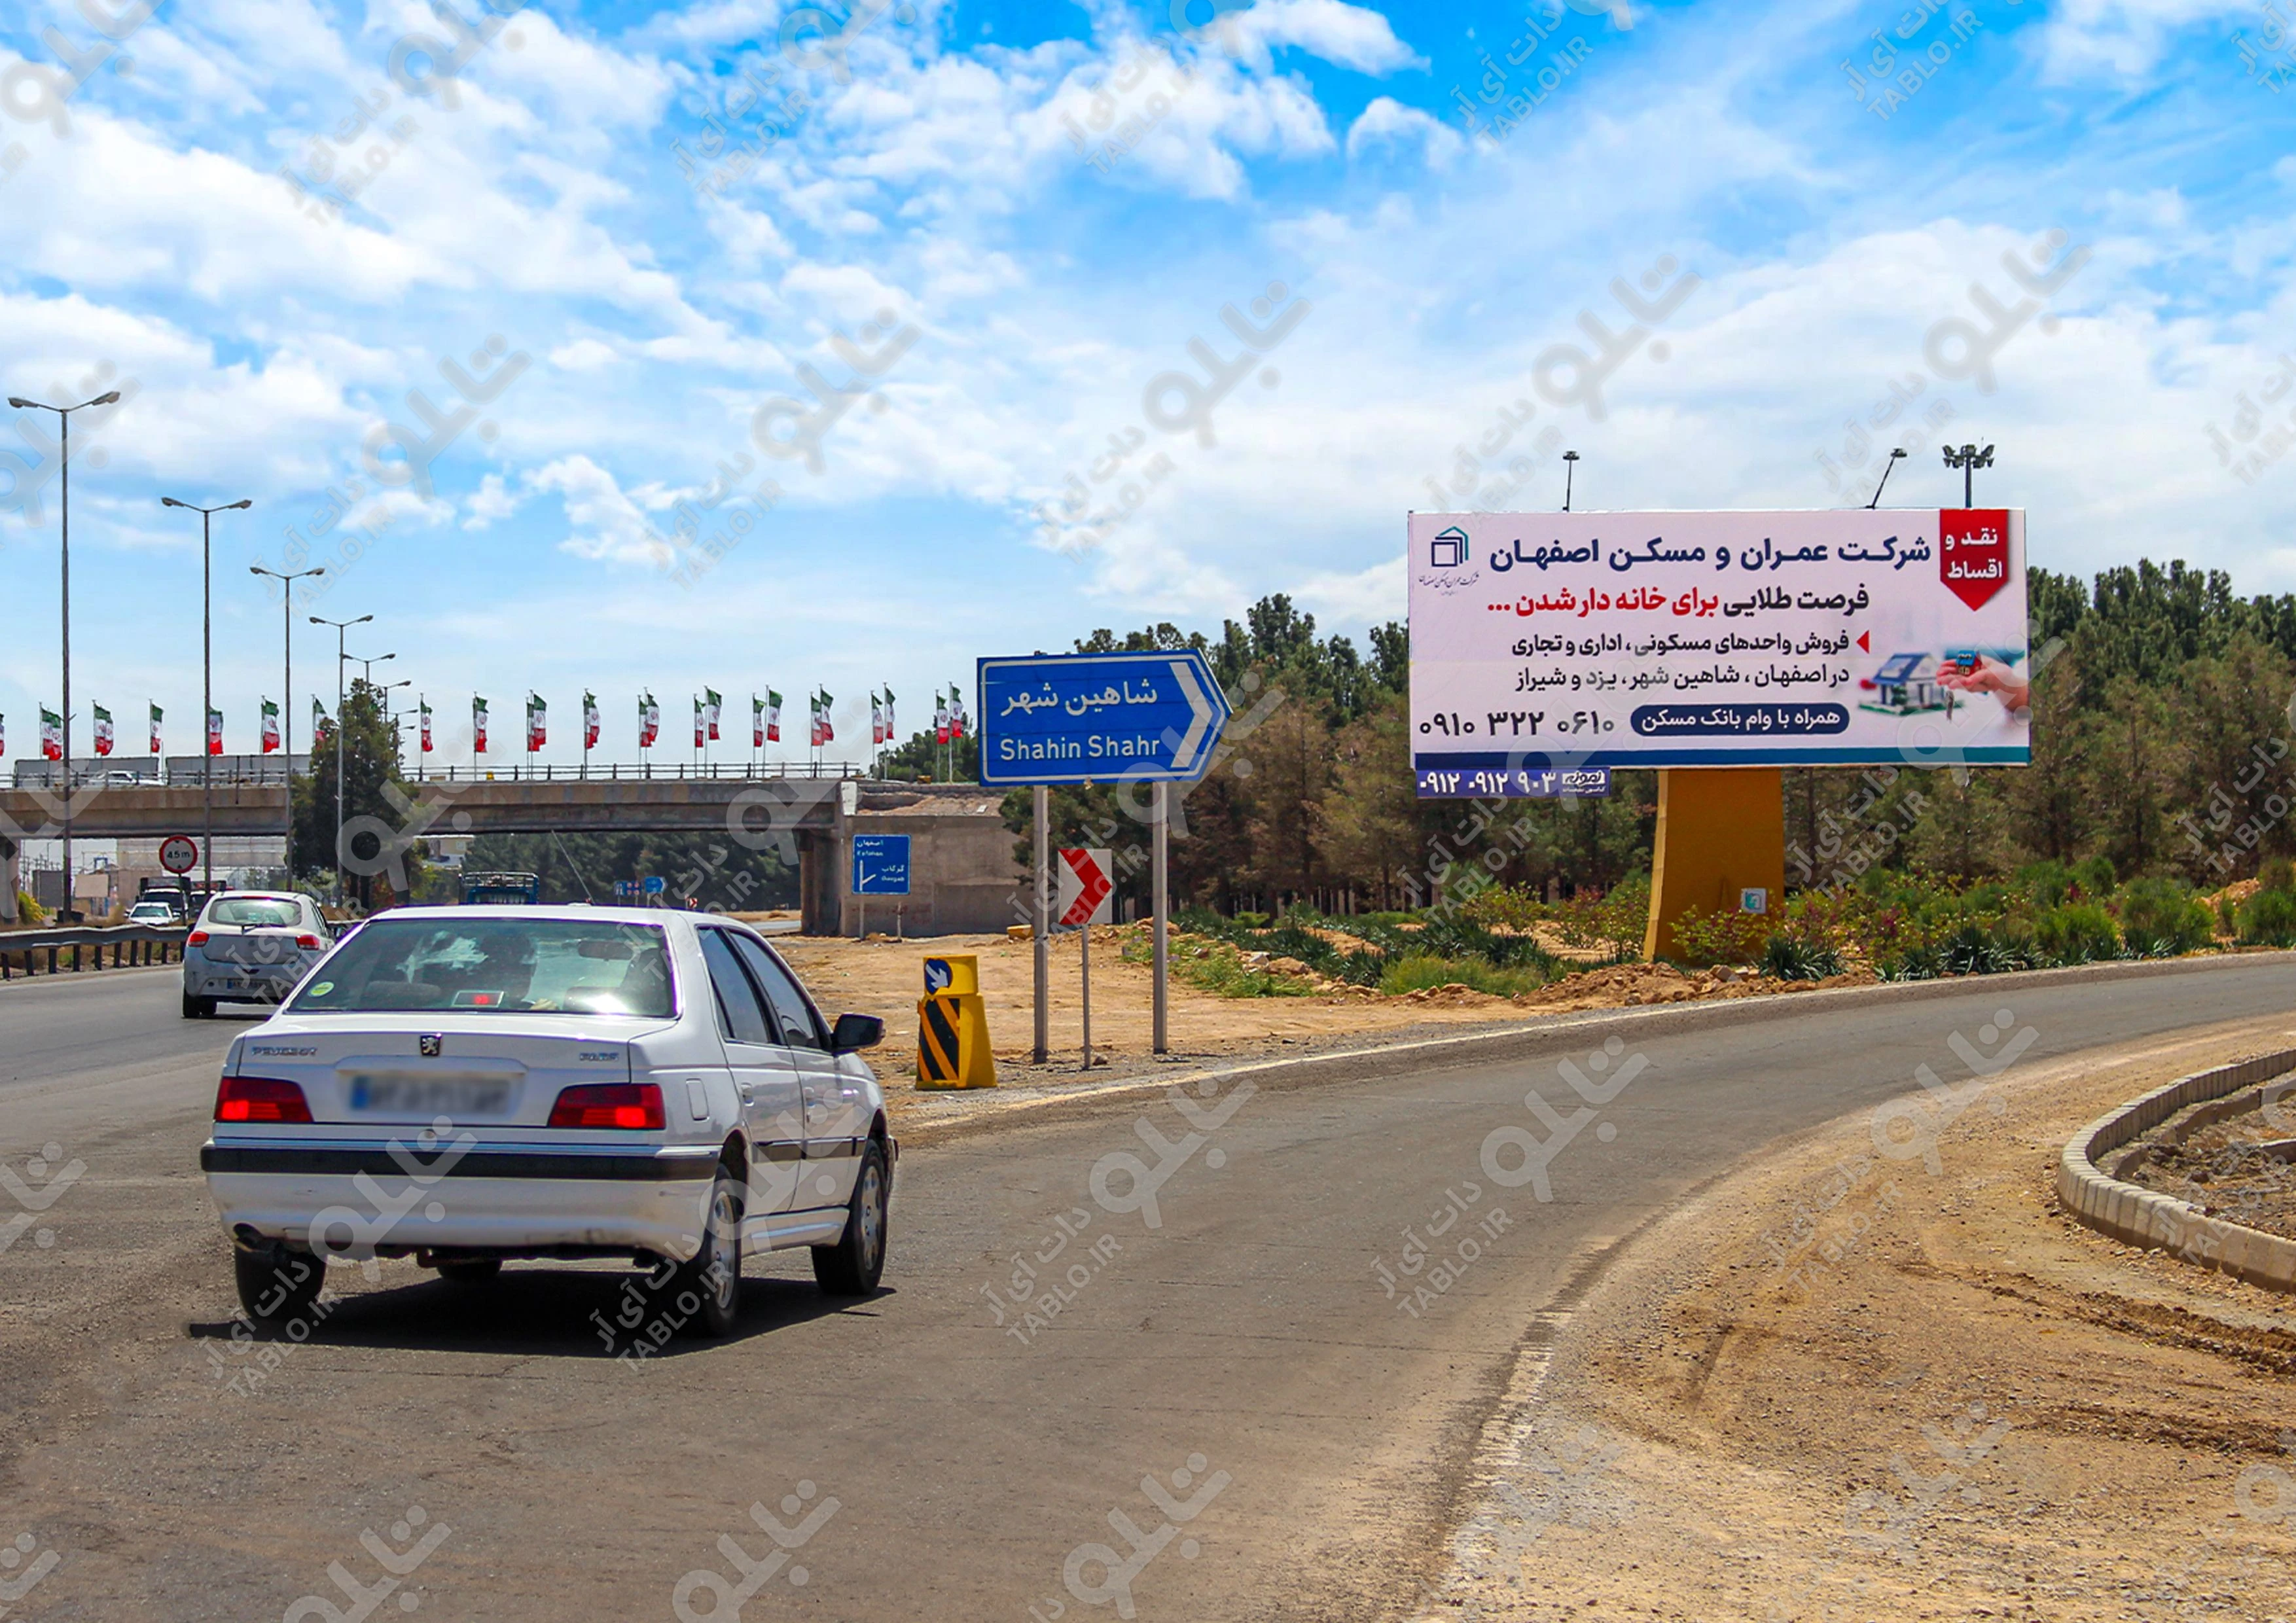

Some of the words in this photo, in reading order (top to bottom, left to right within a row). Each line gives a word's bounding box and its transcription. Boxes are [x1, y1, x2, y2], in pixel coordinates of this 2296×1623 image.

[1945, 533, 1956, 552] و
[1961, 527, 1998, 546] نقد
[1490, 539, 1599, 572] اصفهان
[1609, 537, 1706, 572] مسکن
[1715, 546, 1731, 571] و
[1741, 538, 1828, 571] عمران
[1838, 537, 1931, 570] شرکت
[1947, 561, 2002, 579] اقساط
[1616, 586, 1666, 610] خانه
[1672, 587, 1719, 617] برای
[1723, 586, 1792, 616] طلایی
[1797, 583, 1869, 616] فرصت
[1512, 634, 1563, 656] تجاری
[1566, 641, 1575, 656] و
[1579, 633, 1623, 656] اداری
[1715, 632, 1793, 656] واحدهای
[1795, 632, 1850, 656] فروش
[1515, 667, 1566, 691] شیراز
[1571, 676, 1581, 690] و
[1585, 671, 1617, 691] یزد
[1674, 664, 1741, 688] شاهین
[1829, 668, 1850, 689] در
[1000, 682, 1059, 717] شهر
[1065, 678, 1158, 716] شاهین
[1420, 713, 1475, 736] ۰۹۱۰
[1487, 711, 1544, 736] ۳۲۲
[1641, 709, 1696, 732] مسکن
[1700, 709, 1742, 729] بانک
[1746, 709, 1773, 730] وام
[1777, 709, 1789, 727] با
[1794, 710, 1840, 726] همراه
[1000, 737, 1081, 760] Shahin
[1088, 735, 1160, 758] Shahr
